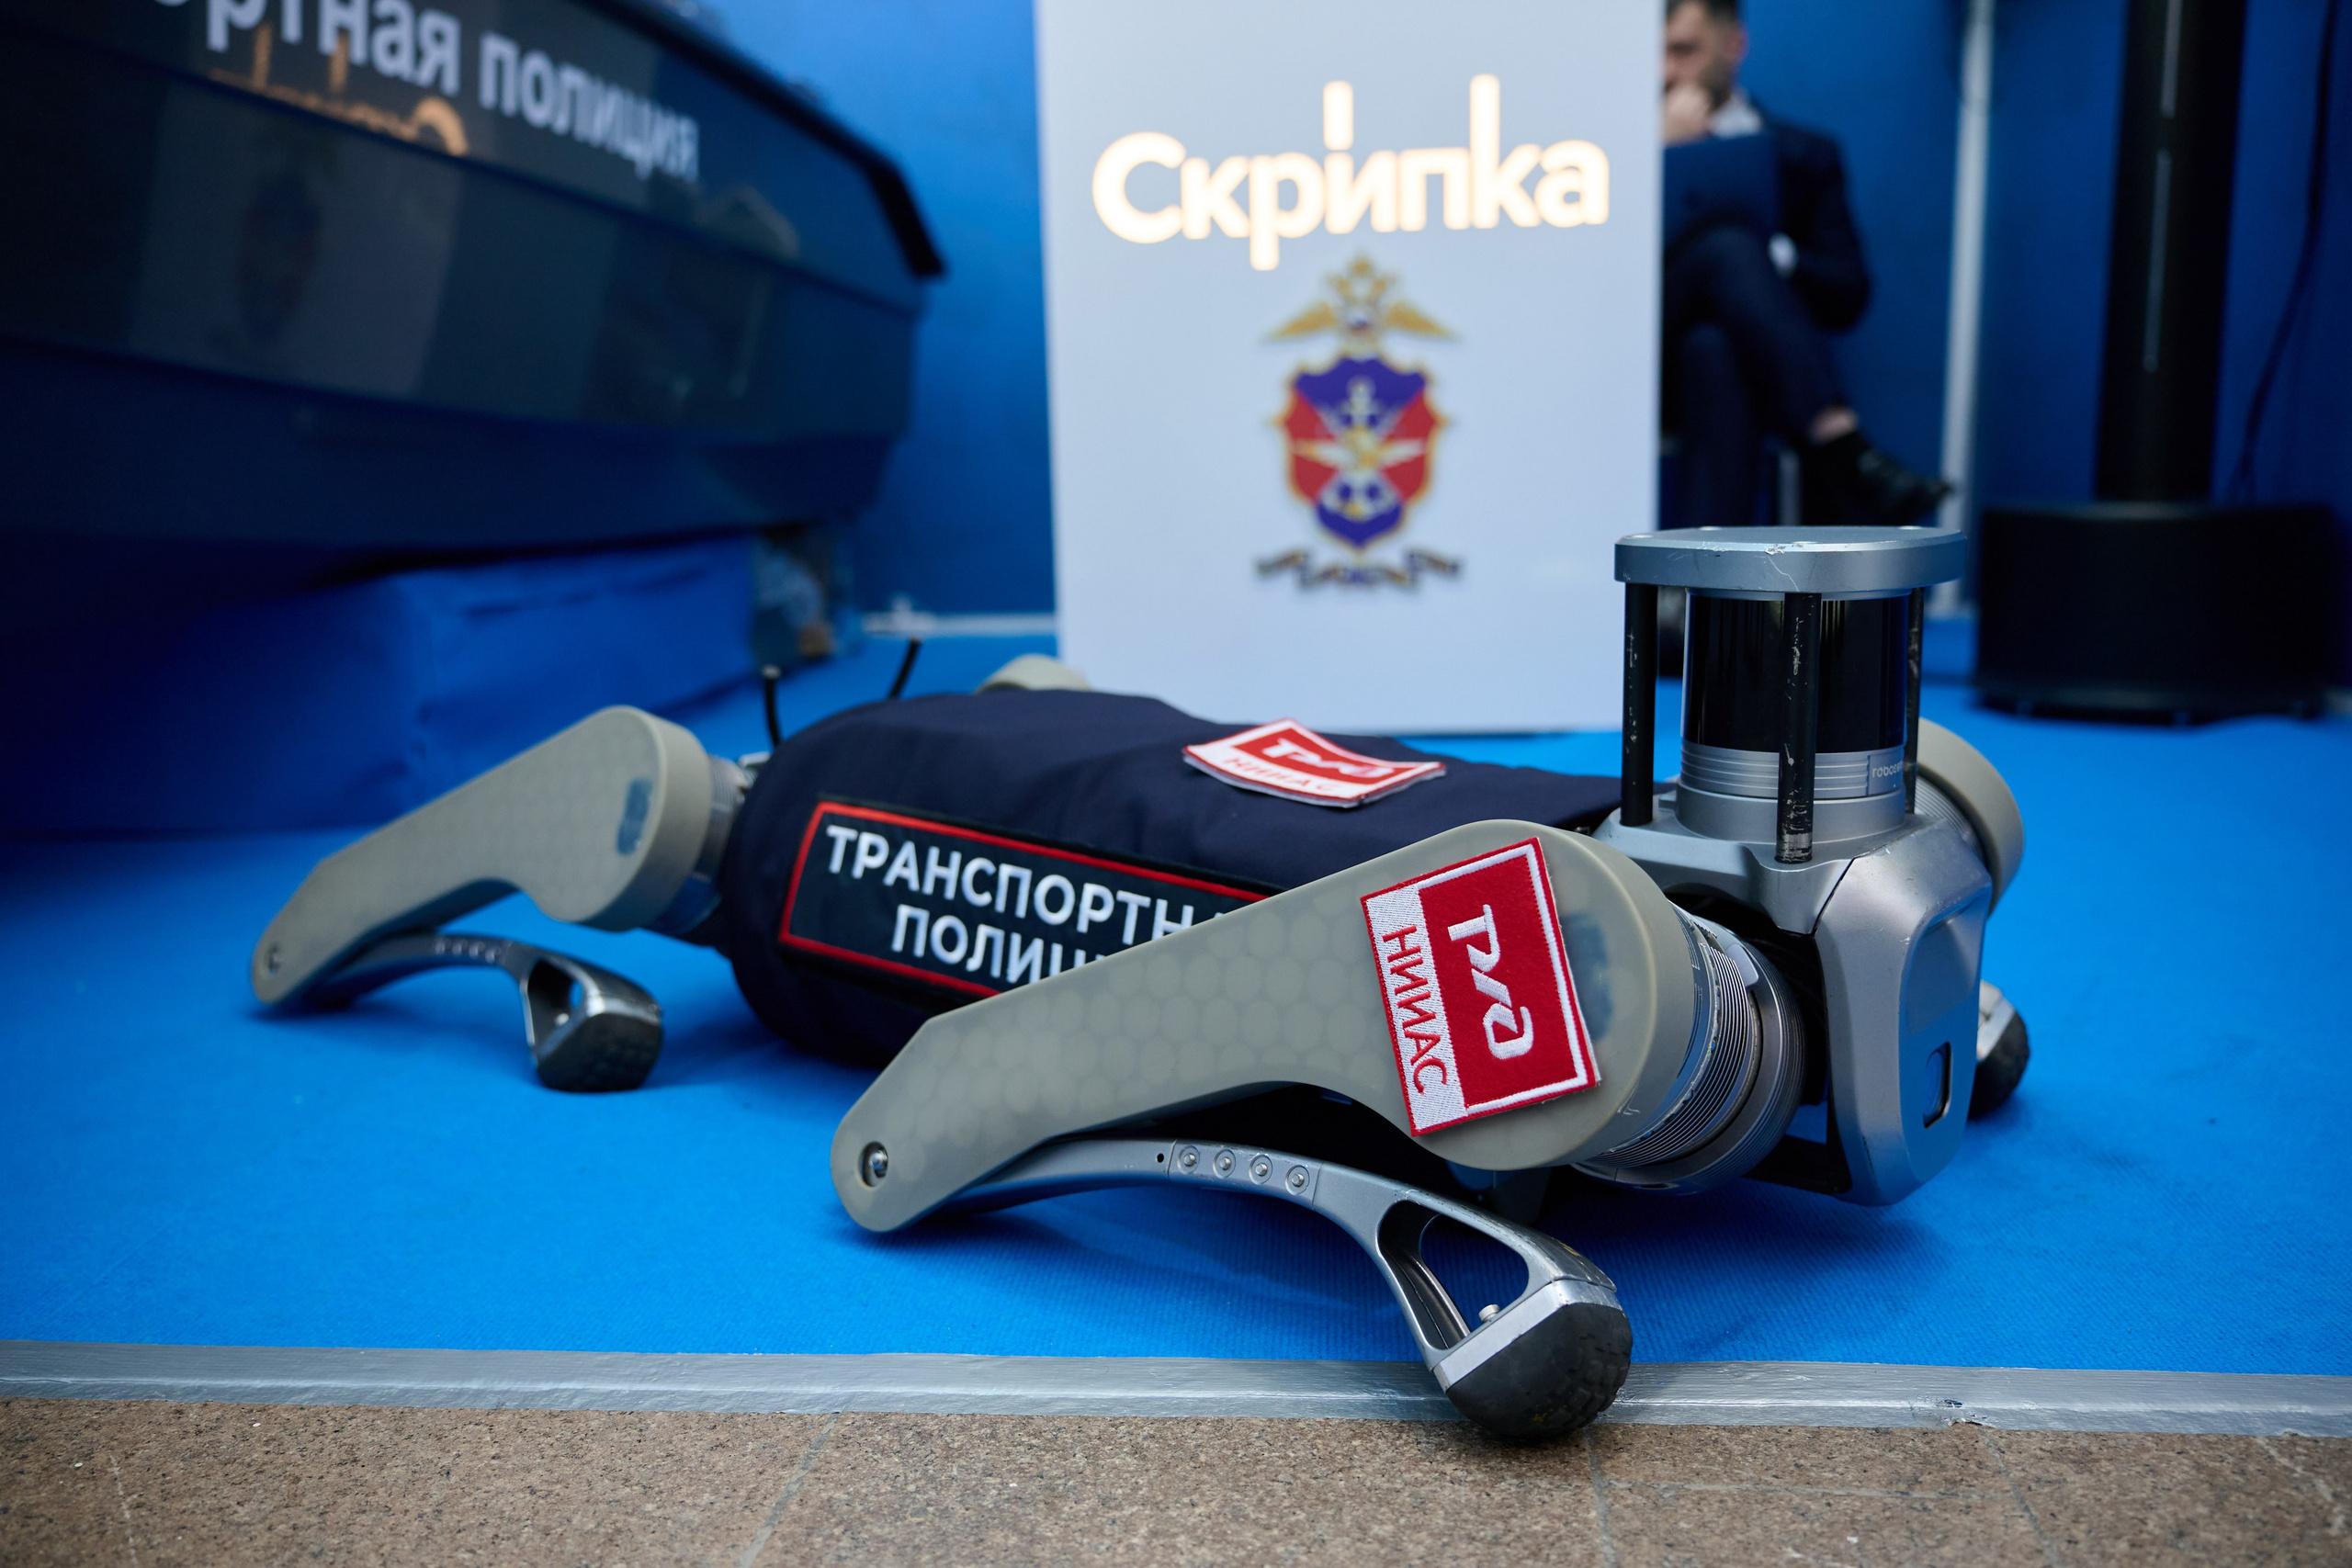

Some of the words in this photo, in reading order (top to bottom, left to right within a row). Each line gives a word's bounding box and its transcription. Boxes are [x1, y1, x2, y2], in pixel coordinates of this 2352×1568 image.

[480, 32, 698, 183] полиция
[1091, 73, 1610, 271] Скрипка
[827, 824, 1225, 945] ТРАНСПОРТН
[891, 904, 1106, 985] ПОЛИ
[1382, 925, 1448, 1095] НИИАС
